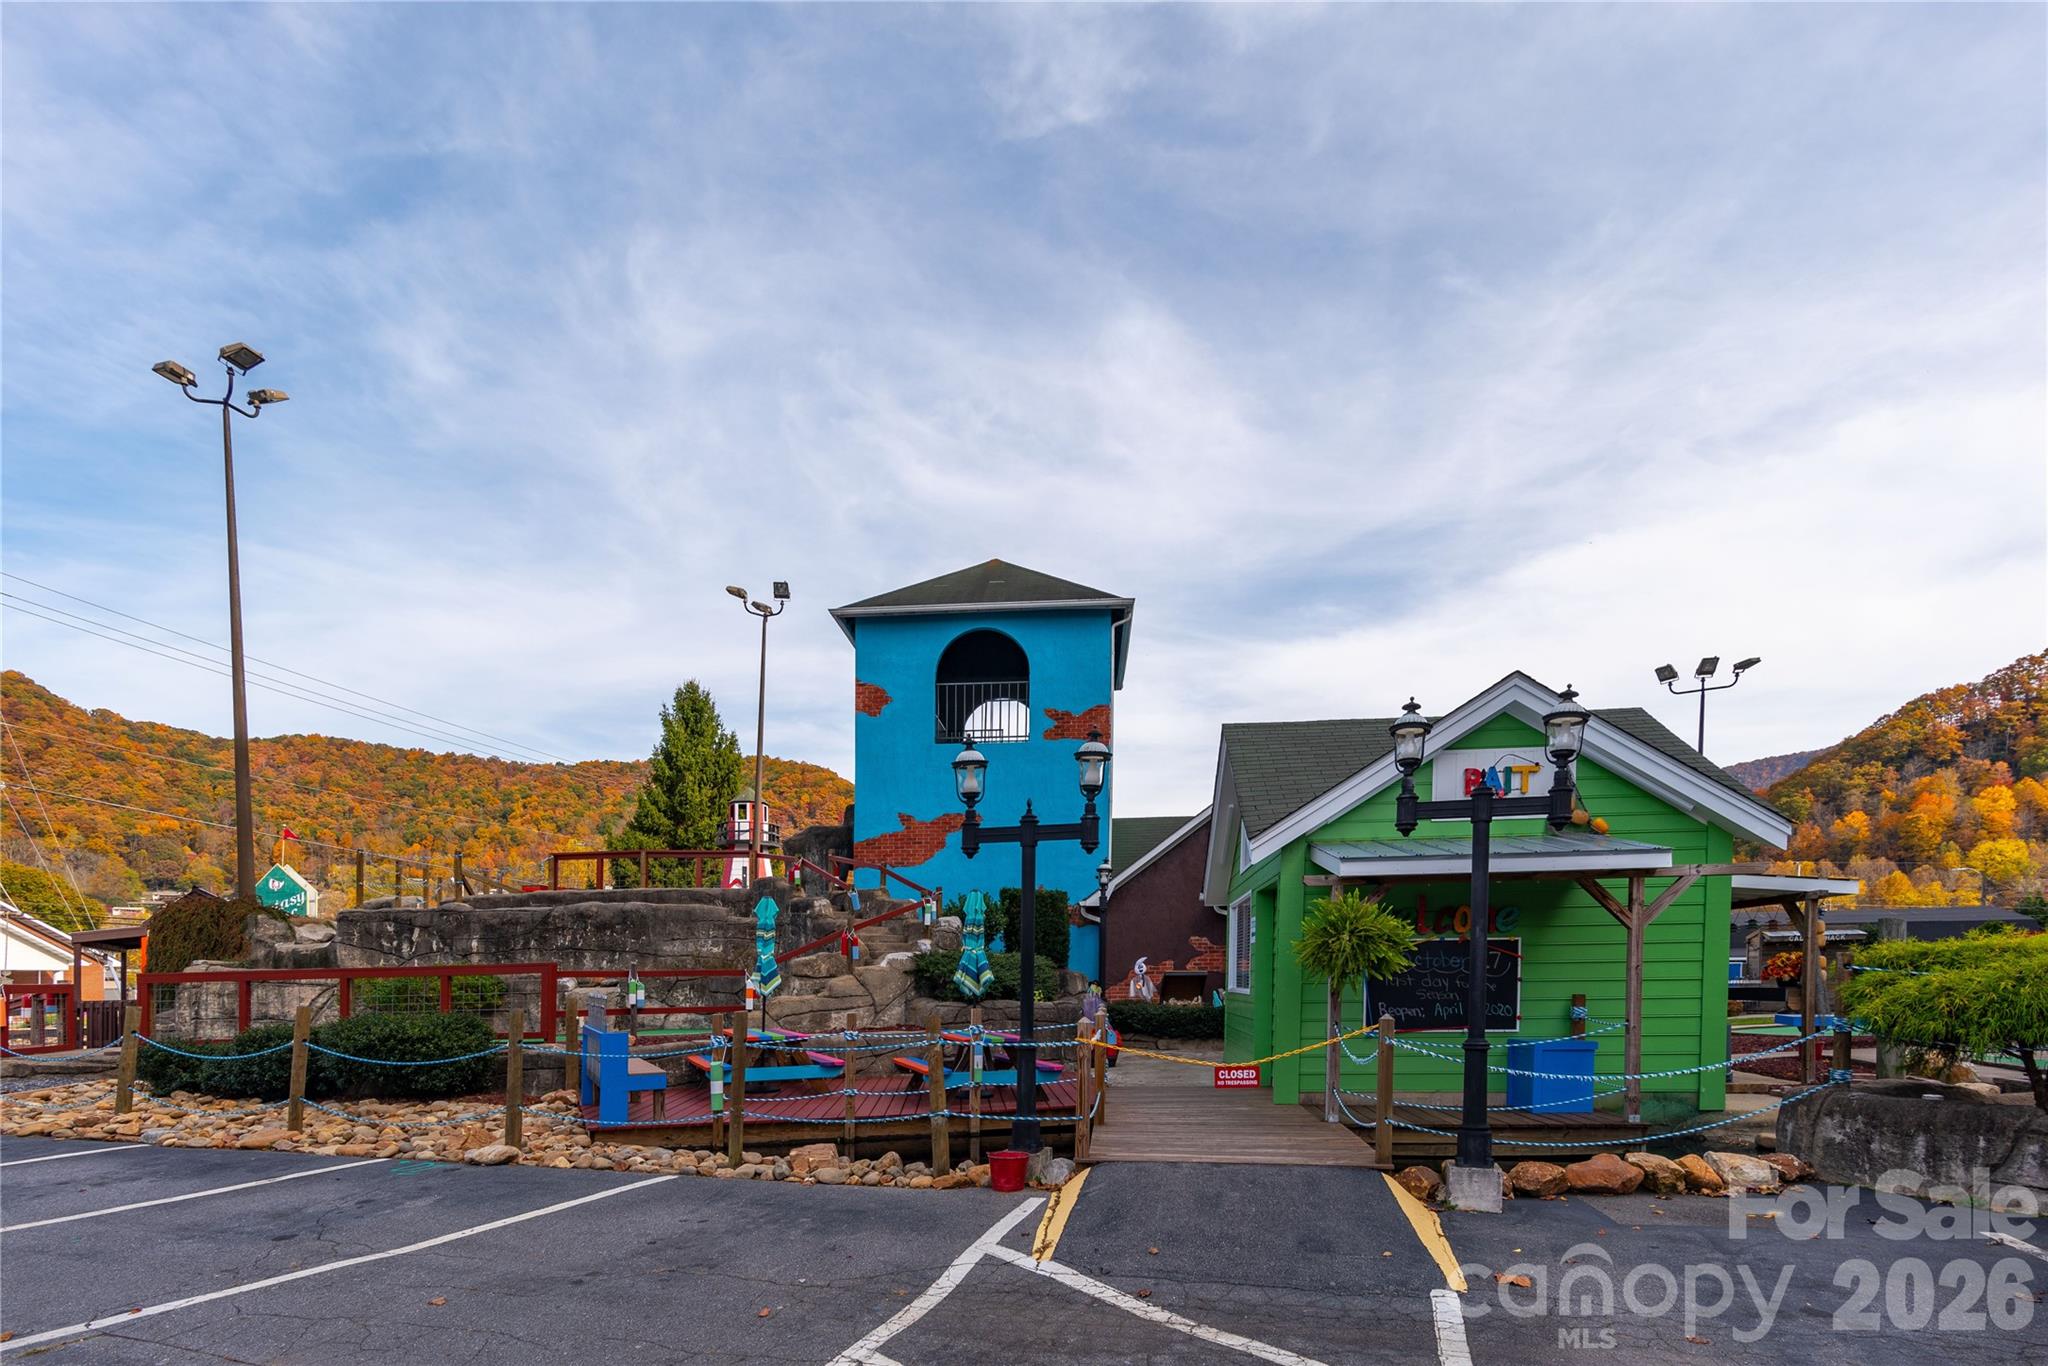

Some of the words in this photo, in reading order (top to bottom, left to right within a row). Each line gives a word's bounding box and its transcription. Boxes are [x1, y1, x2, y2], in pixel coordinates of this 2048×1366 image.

[1410, 949, 1470, 969] ctober
[1421, 973, 1449, 991] day
[1457, 975, 1470, 989] fo
[1434, 1001, 1463, 1021] April
[1485, 1002, 1513, 1017] 2020
[1219, 1069, 1256, 1079] CLOSED
